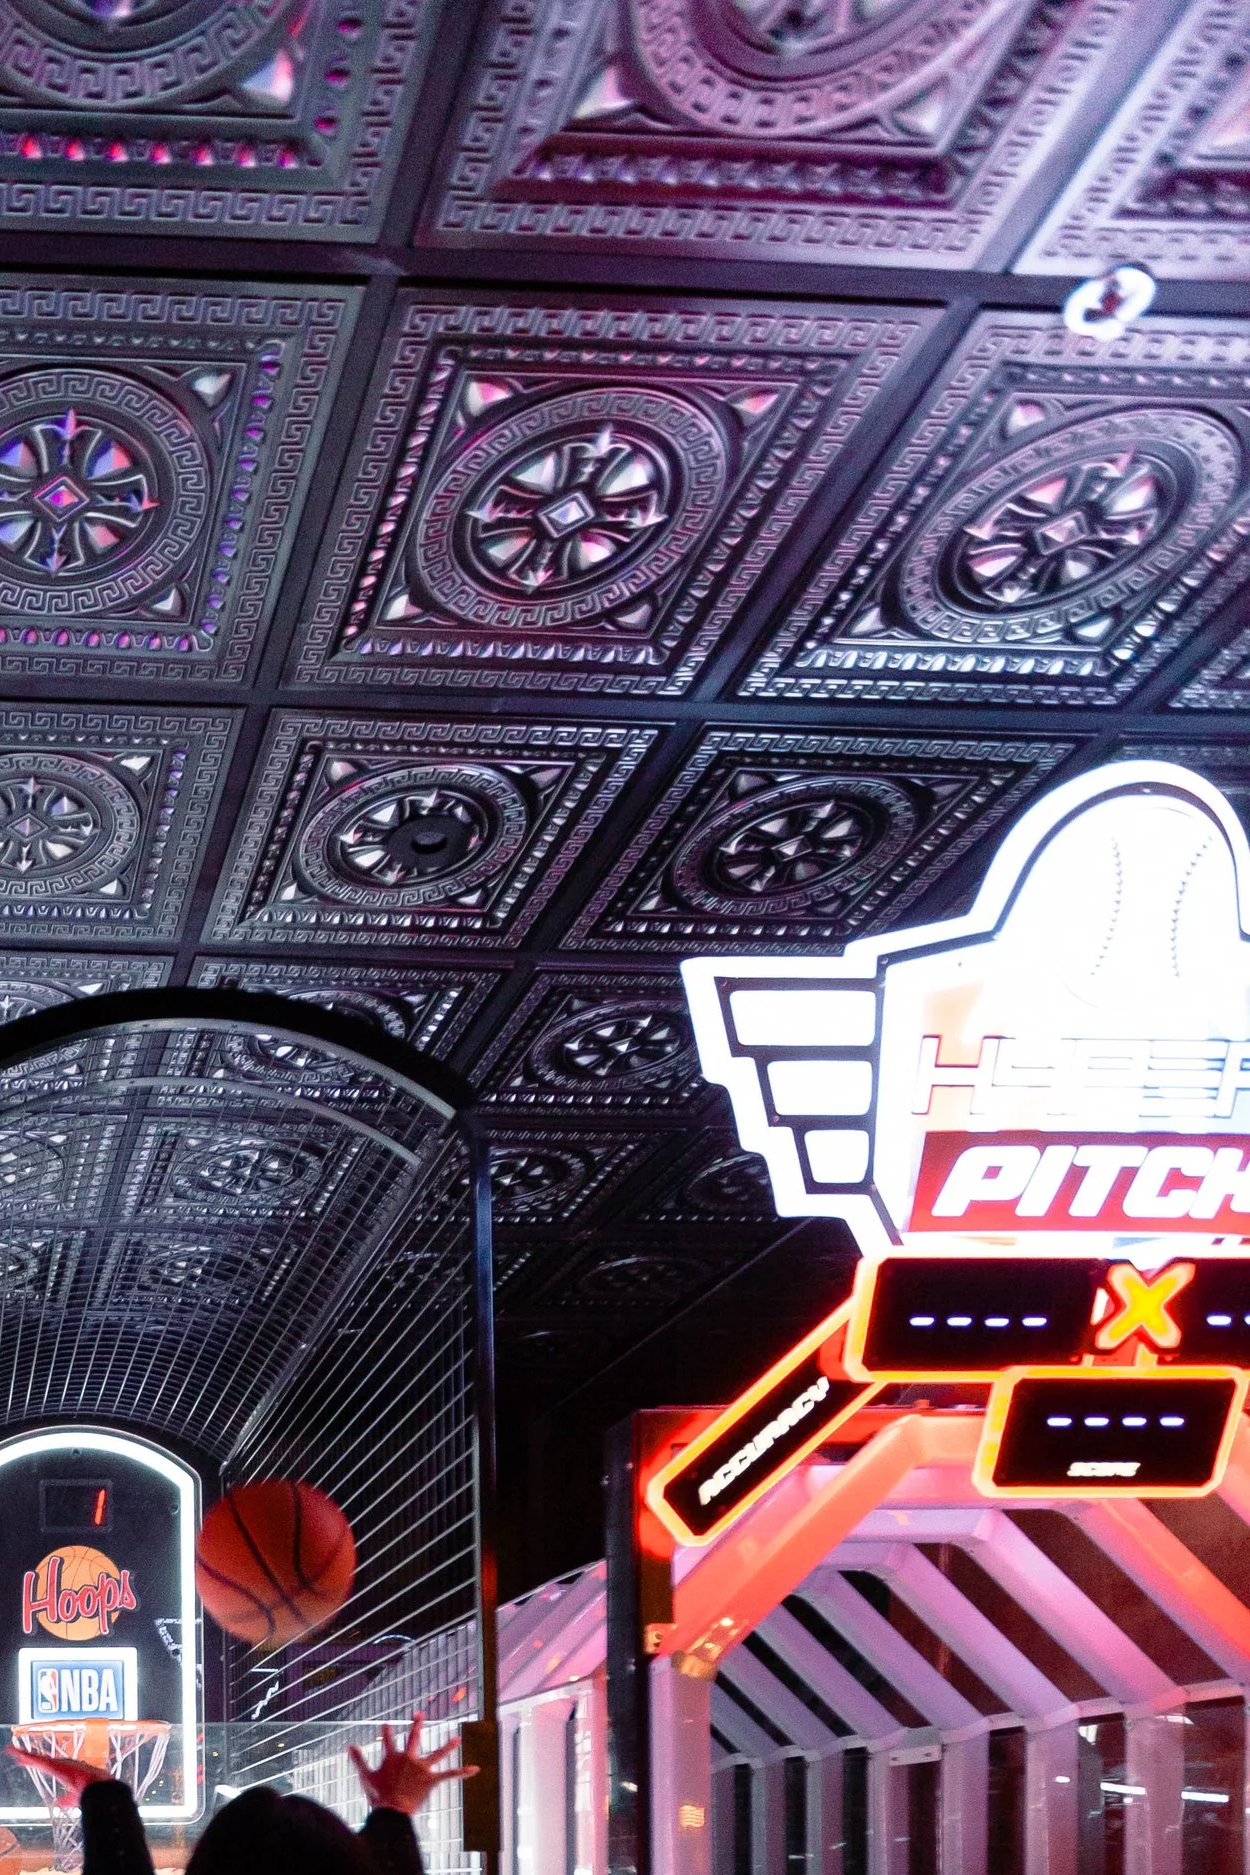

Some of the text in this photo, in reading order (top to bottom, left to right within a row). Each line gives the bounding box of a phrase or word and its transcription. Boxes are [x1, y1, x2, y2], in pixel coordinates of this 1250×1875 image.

[931, 1144, 1250, 1219] PITCH
[698, 1375, 830, 1506] ACCURACY
[93, 1489, 106, 1527] 1
[22, 1556, 138, 1635] Hoops
[60, 1667, 118, 1713] NBA
